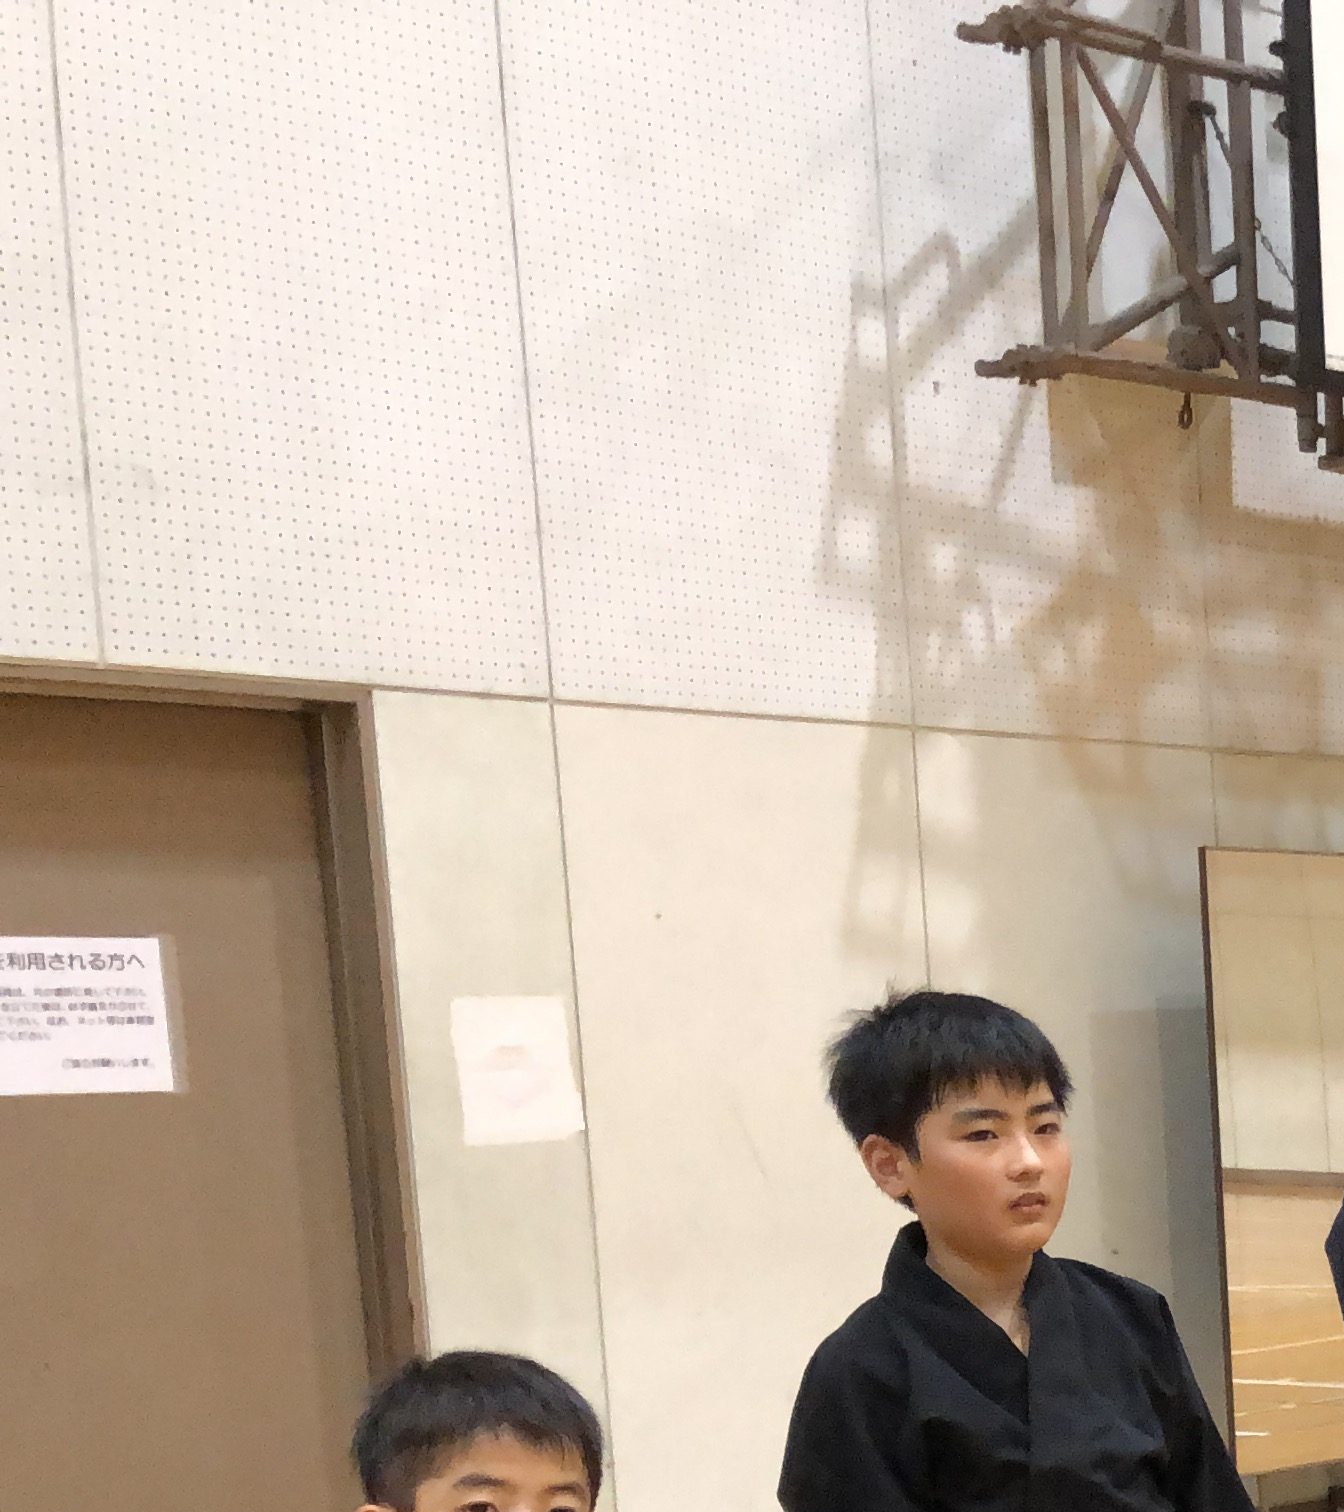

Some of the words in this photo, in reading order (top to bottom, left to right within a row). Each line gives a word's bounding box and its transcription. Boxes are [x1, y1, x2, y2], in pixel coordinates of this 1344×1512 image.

[0, 952, 146, 971] 利用される方へ
